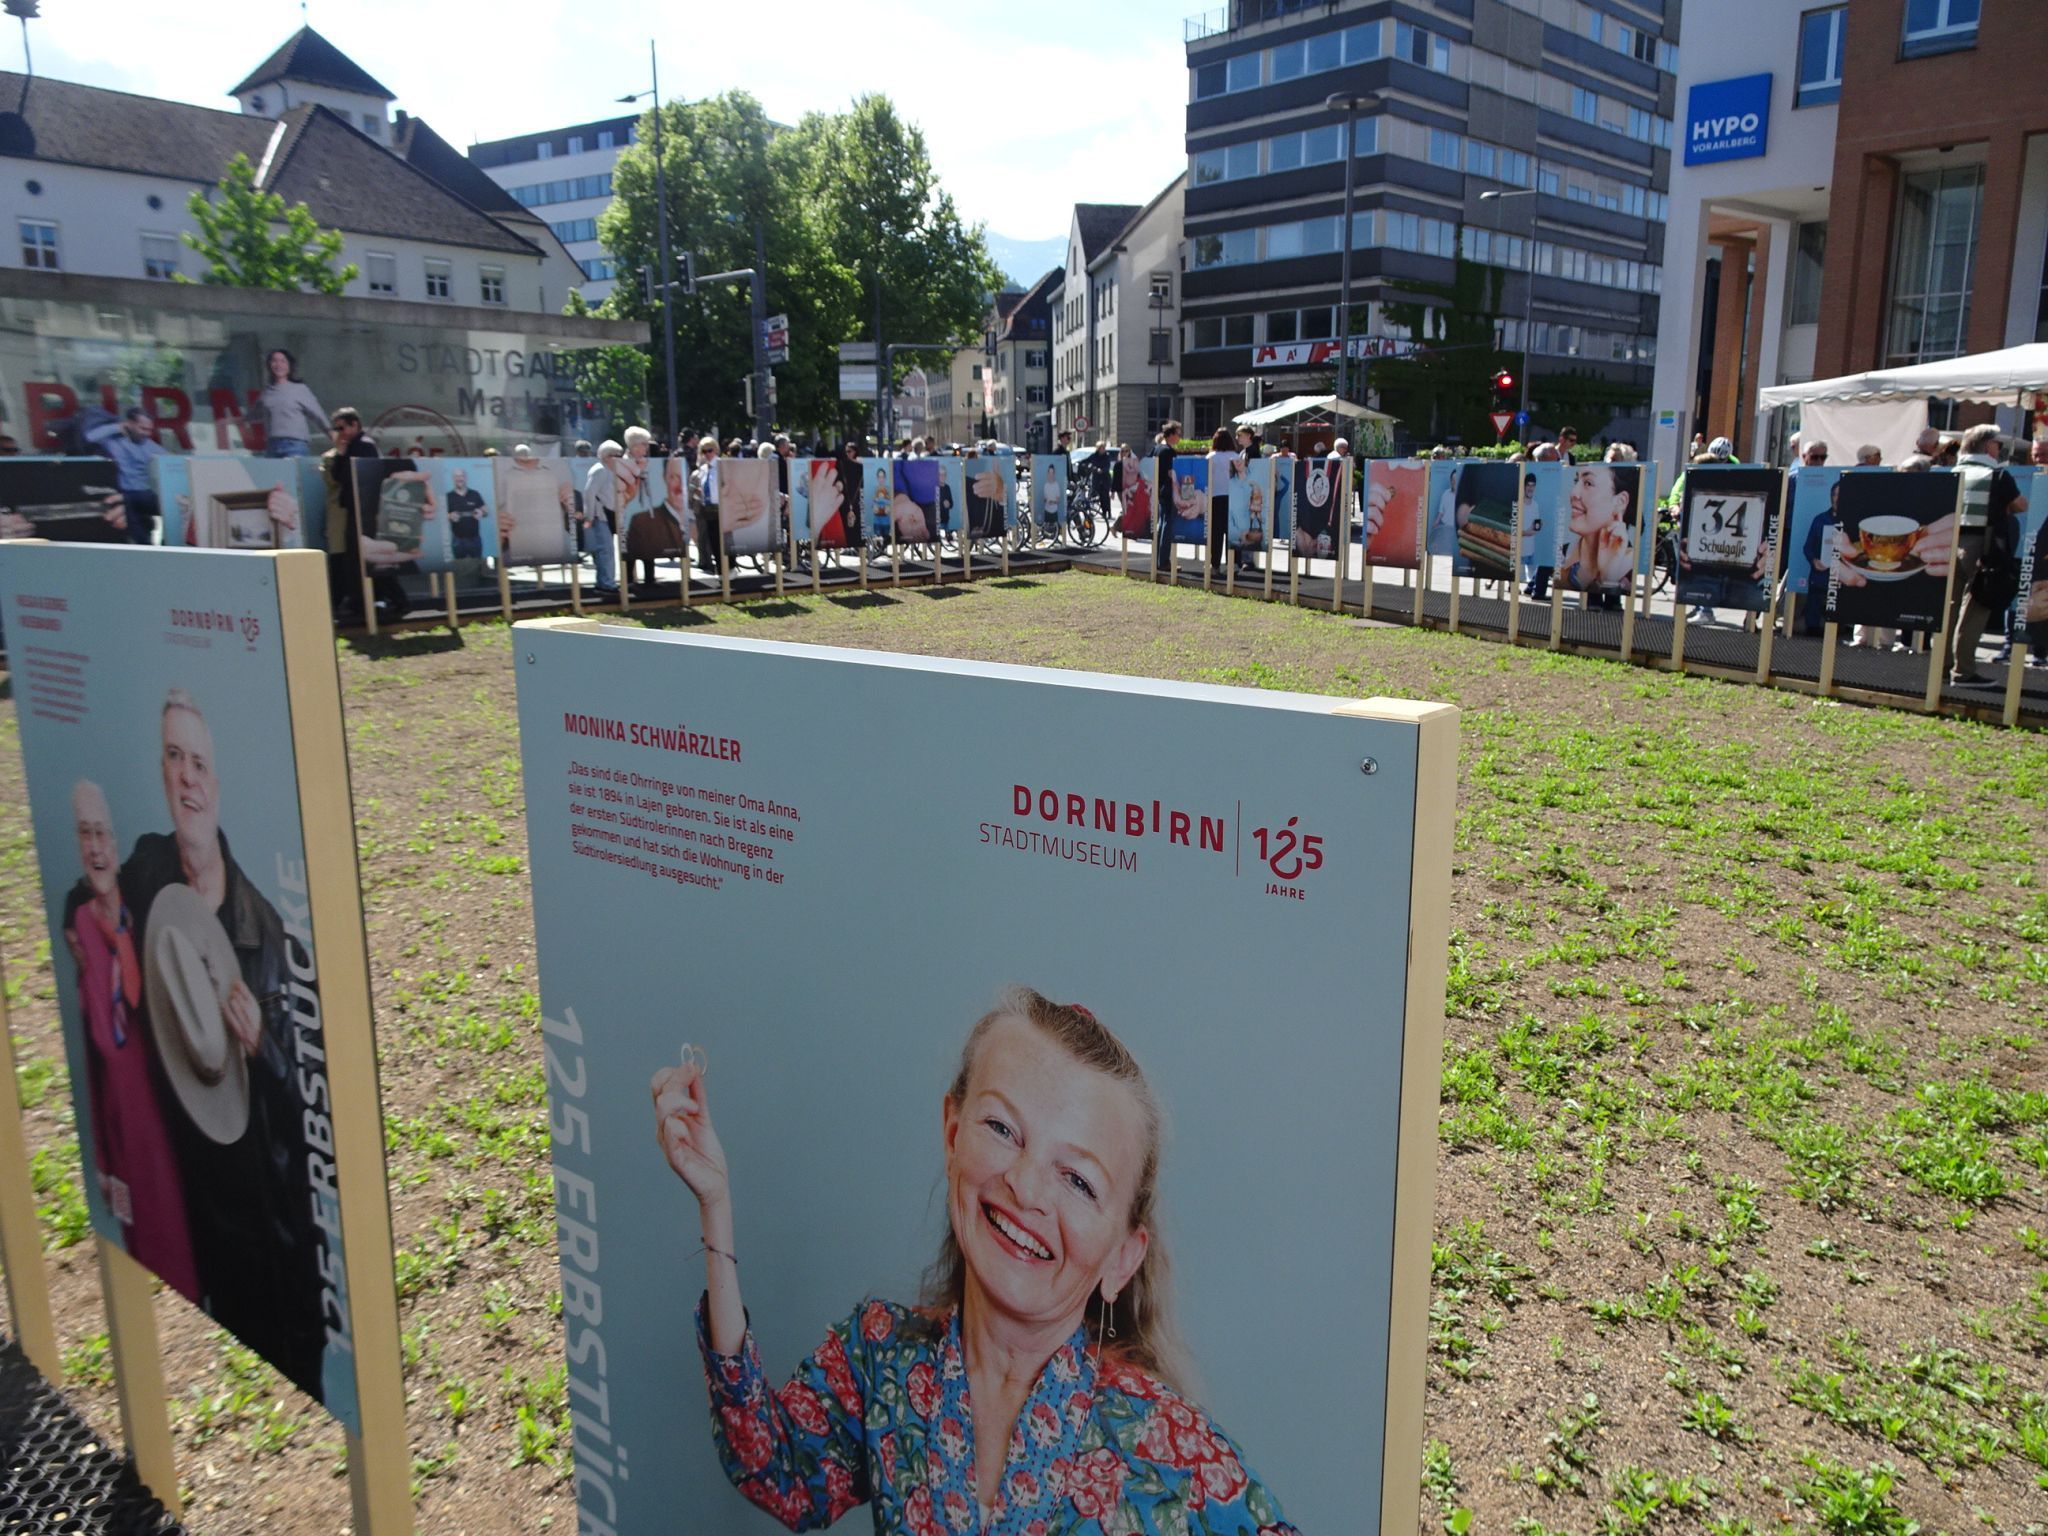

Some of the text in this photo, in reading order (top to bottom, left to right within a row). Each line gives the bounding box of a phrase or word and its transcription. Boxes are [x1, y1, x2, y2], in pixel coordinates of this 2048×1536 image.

[1692, 136, 1757, 153] VORARLBERG
[1693, 113, 1759, 141] HYPO
[1702, 498, 1748, 538] 34
[564, 713, 741, 762] MONIKA SCHWÄRZLER
[569, 782, 794, 841] sie ist 1894 in Lajen geboren. Sie ist als eine
[592, 765, 610, 780] sind
[614, 770, 627, 784] die
[631, 772, 674, 795] Ohrringe
[676, 784, 695, 798] von
[698, 788, 735, 806] meiner
[739, 794, 764, 812] Oma
[768, 800, 801, 822] Anna,
[570, 802, 773, 859] der ersten Südtirolerinnen nach Bregenz
[572, 823, 784, 885] gekommen und hat sich die Wohnung in der
[979, 822, 1138, 873] STADTMUSEUM
[1013, 784, 1323, 880] DORNBIRN 125
[573, 840, 657, 877] Südtirolersiedlung
[1266, 882, 1305, 900] JAHRE
[277, 852, 356, 1354] 125 ERBSTÜCKE
[541, 1006, 591, 1156] 125
